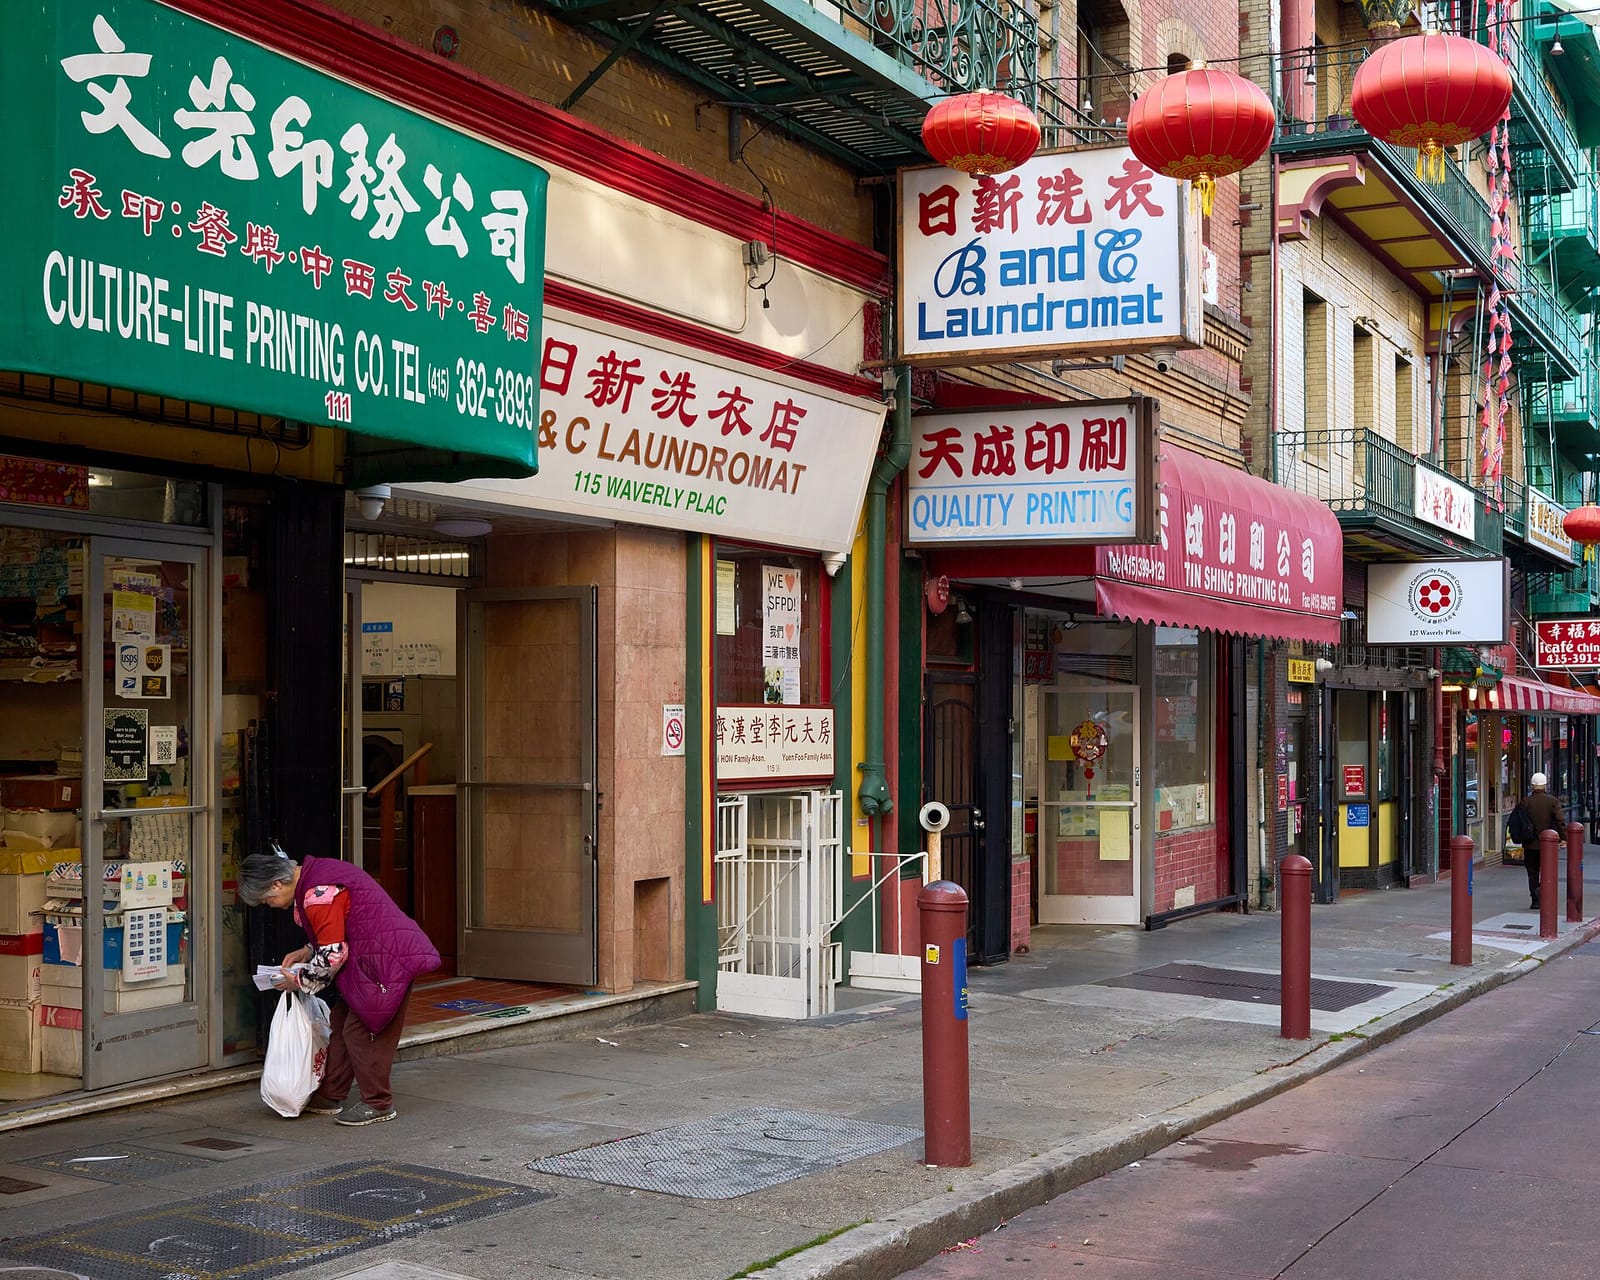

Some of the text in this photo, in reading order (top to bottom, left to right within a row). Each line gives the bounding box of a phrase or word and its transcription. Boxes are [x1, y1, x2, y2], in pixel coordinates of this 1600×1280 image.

[60, 14, 527, 284] 文光印務公司
[918, 158, 1164, 236] 日新洗衣
[999, 229, 1085, 287] and
[1094, 227, 1142, 285] C
[917, 283, 1164, 341] Laundromat
[43, 249, 534, 431] CULTURE-LITE PRINTING CO. TEL (415) 362-3893
[324, 390, 352, 423] 111
[540, 336, 809, 453] 日新洗衣店
[538, 409, 808, 496] & C LAUNDROMAT
[918, 416, 1128, 479] 天成印刷
[573, 470, 728, 517] 115 WAVERLY PLAC
[912, 487, 1133, 532] QUALITY PRINTING
[768, 573, 784, 589] WE
[768, 595, 796, 612] SFPD!
[1184, 561, 1291, 605] TIN SHING PRINTING CO.
[765, 645, 799, 660] 三藩市警察
[770, 625, 784, 639] 我們
[720, 754, 733, 763] HON
[734, 754, 751, 765] Family
[782, 753, 795, 761] Yuen
[795, 753, 804, 761] Foo
[804, 753, 819, 762] Family
